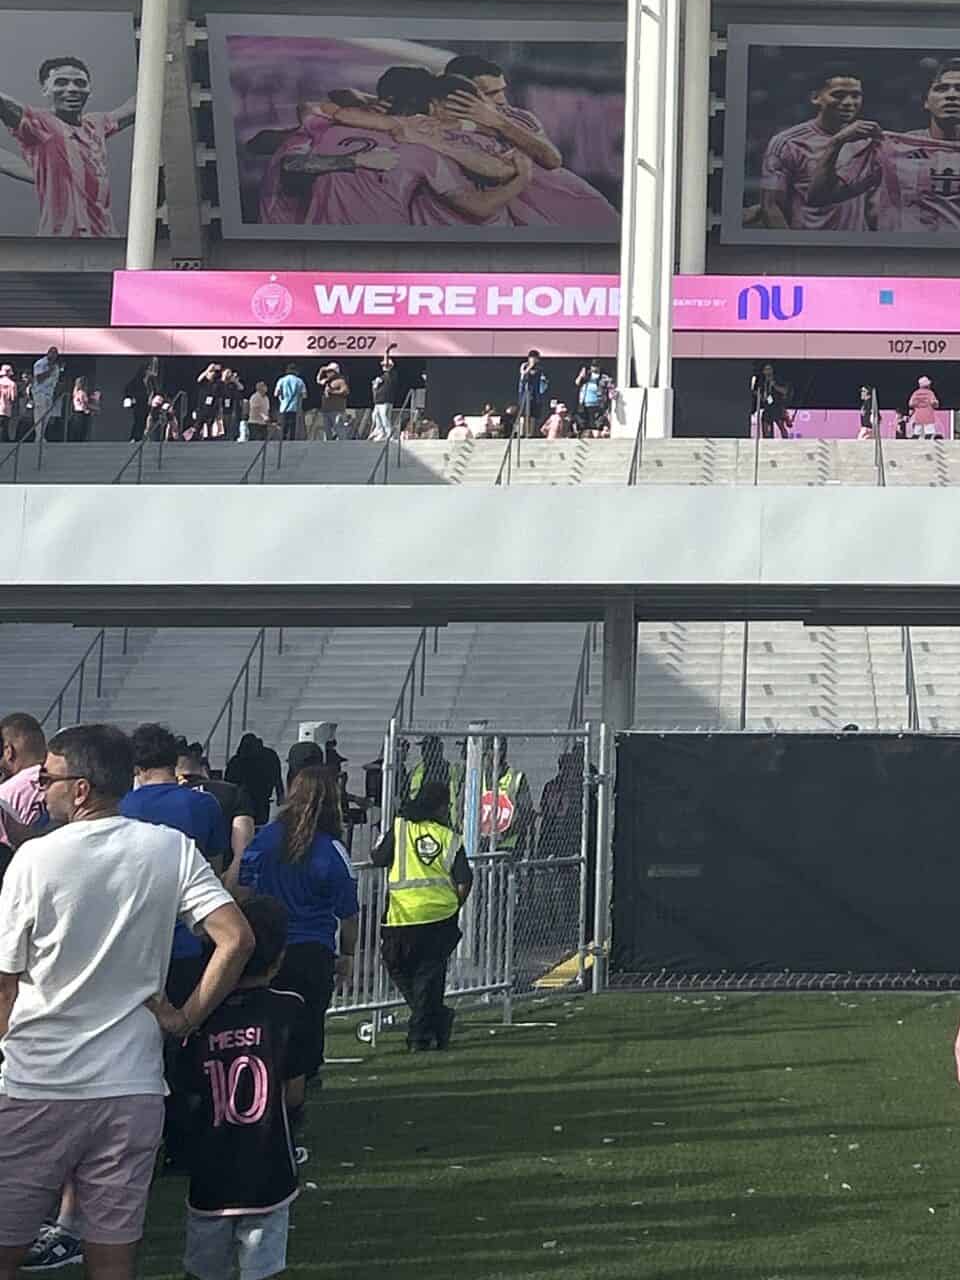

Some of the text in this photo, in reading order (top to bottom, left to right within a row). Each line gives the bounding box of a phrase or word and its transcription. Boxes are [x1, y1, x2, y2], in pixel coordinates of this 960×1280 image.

[314, 284, 476, 316] WE'RE
[209, 1027, 262, 1052] MESSI
[203, 1055, 269, 1127] 10
